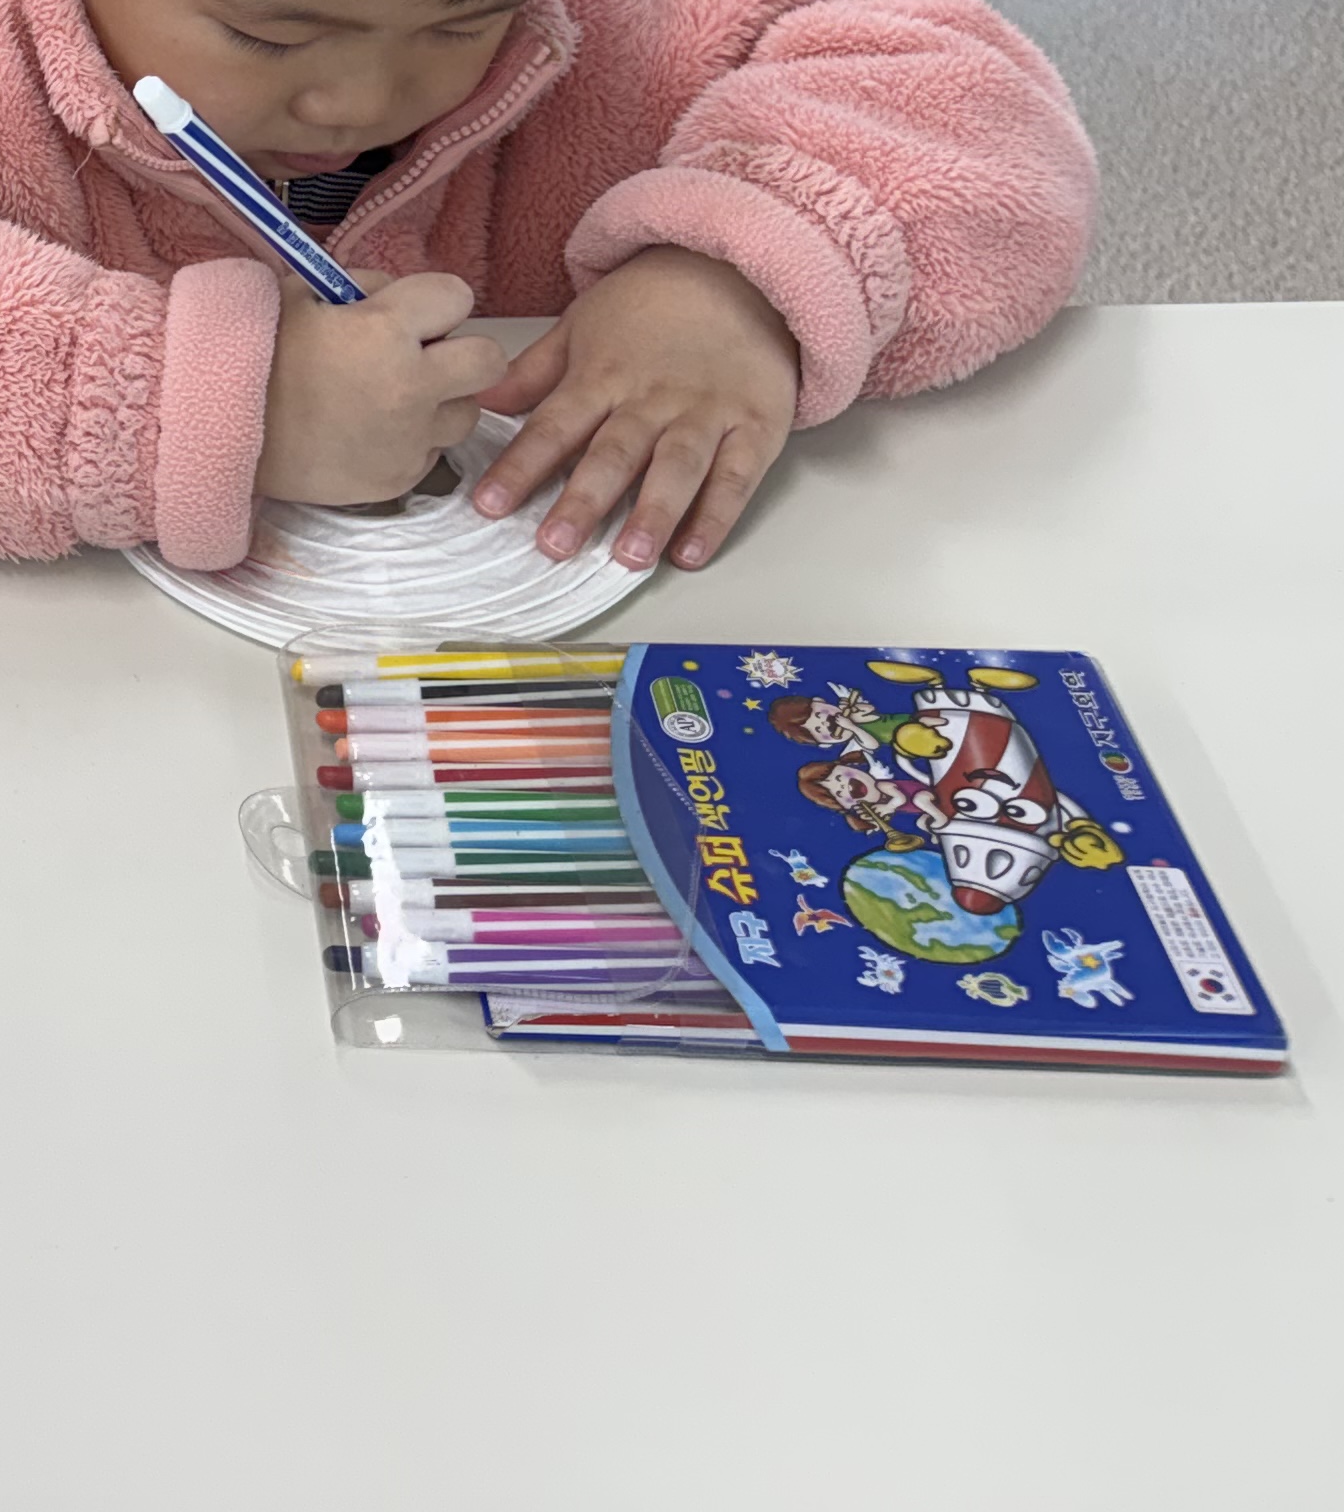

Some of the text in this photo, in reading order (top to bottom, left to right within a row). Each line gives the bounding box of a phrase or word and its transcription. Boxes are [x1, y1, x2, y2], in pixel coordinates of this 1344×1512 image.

[1058, 669, 1120, 748] 지구화학
[675, 748, 731, 831] 색연필
[694, 834, 761, 906] 슈퍼
[733, 910, 784, 969] 지구
